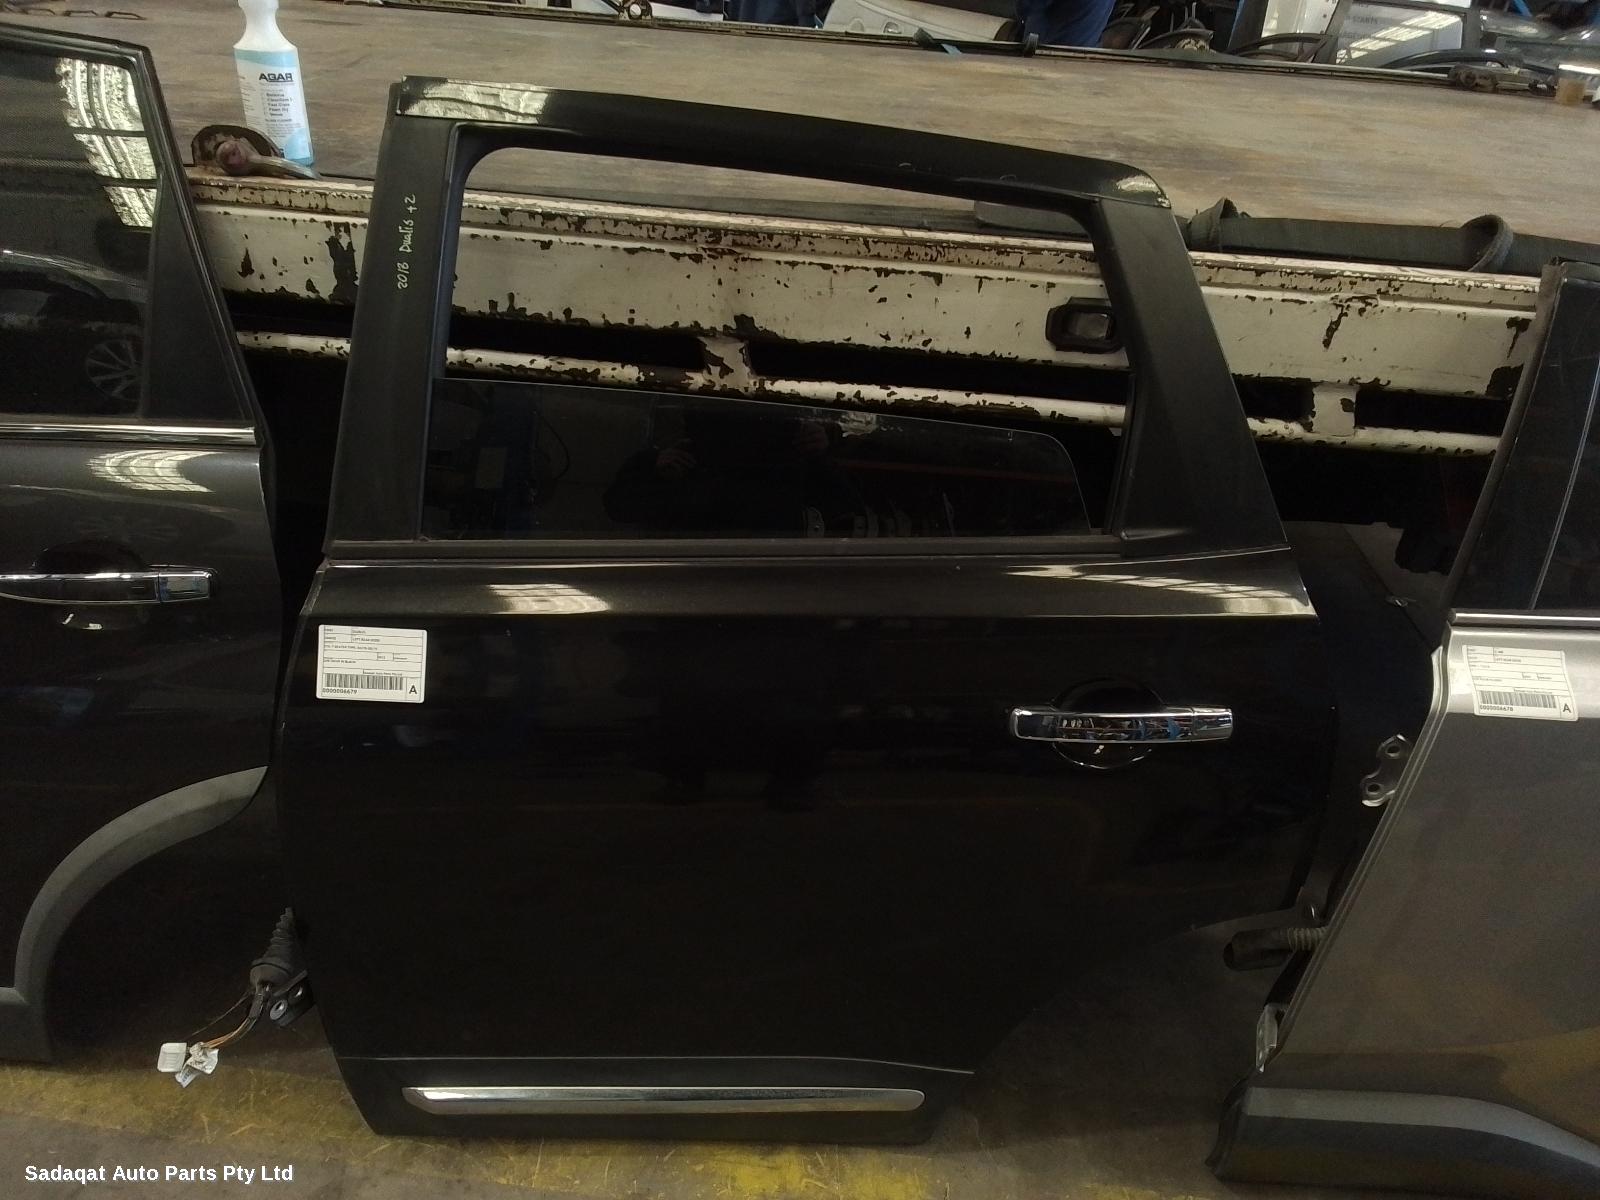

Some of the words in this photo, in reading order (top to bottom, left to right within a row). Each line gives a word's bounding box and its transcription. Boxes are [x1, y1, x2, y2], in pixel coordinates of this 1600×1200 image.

[259, 73, 293, 82] AGAR
[408, 685, 418, 695] A
[1562, 703, 1572, 714] A
